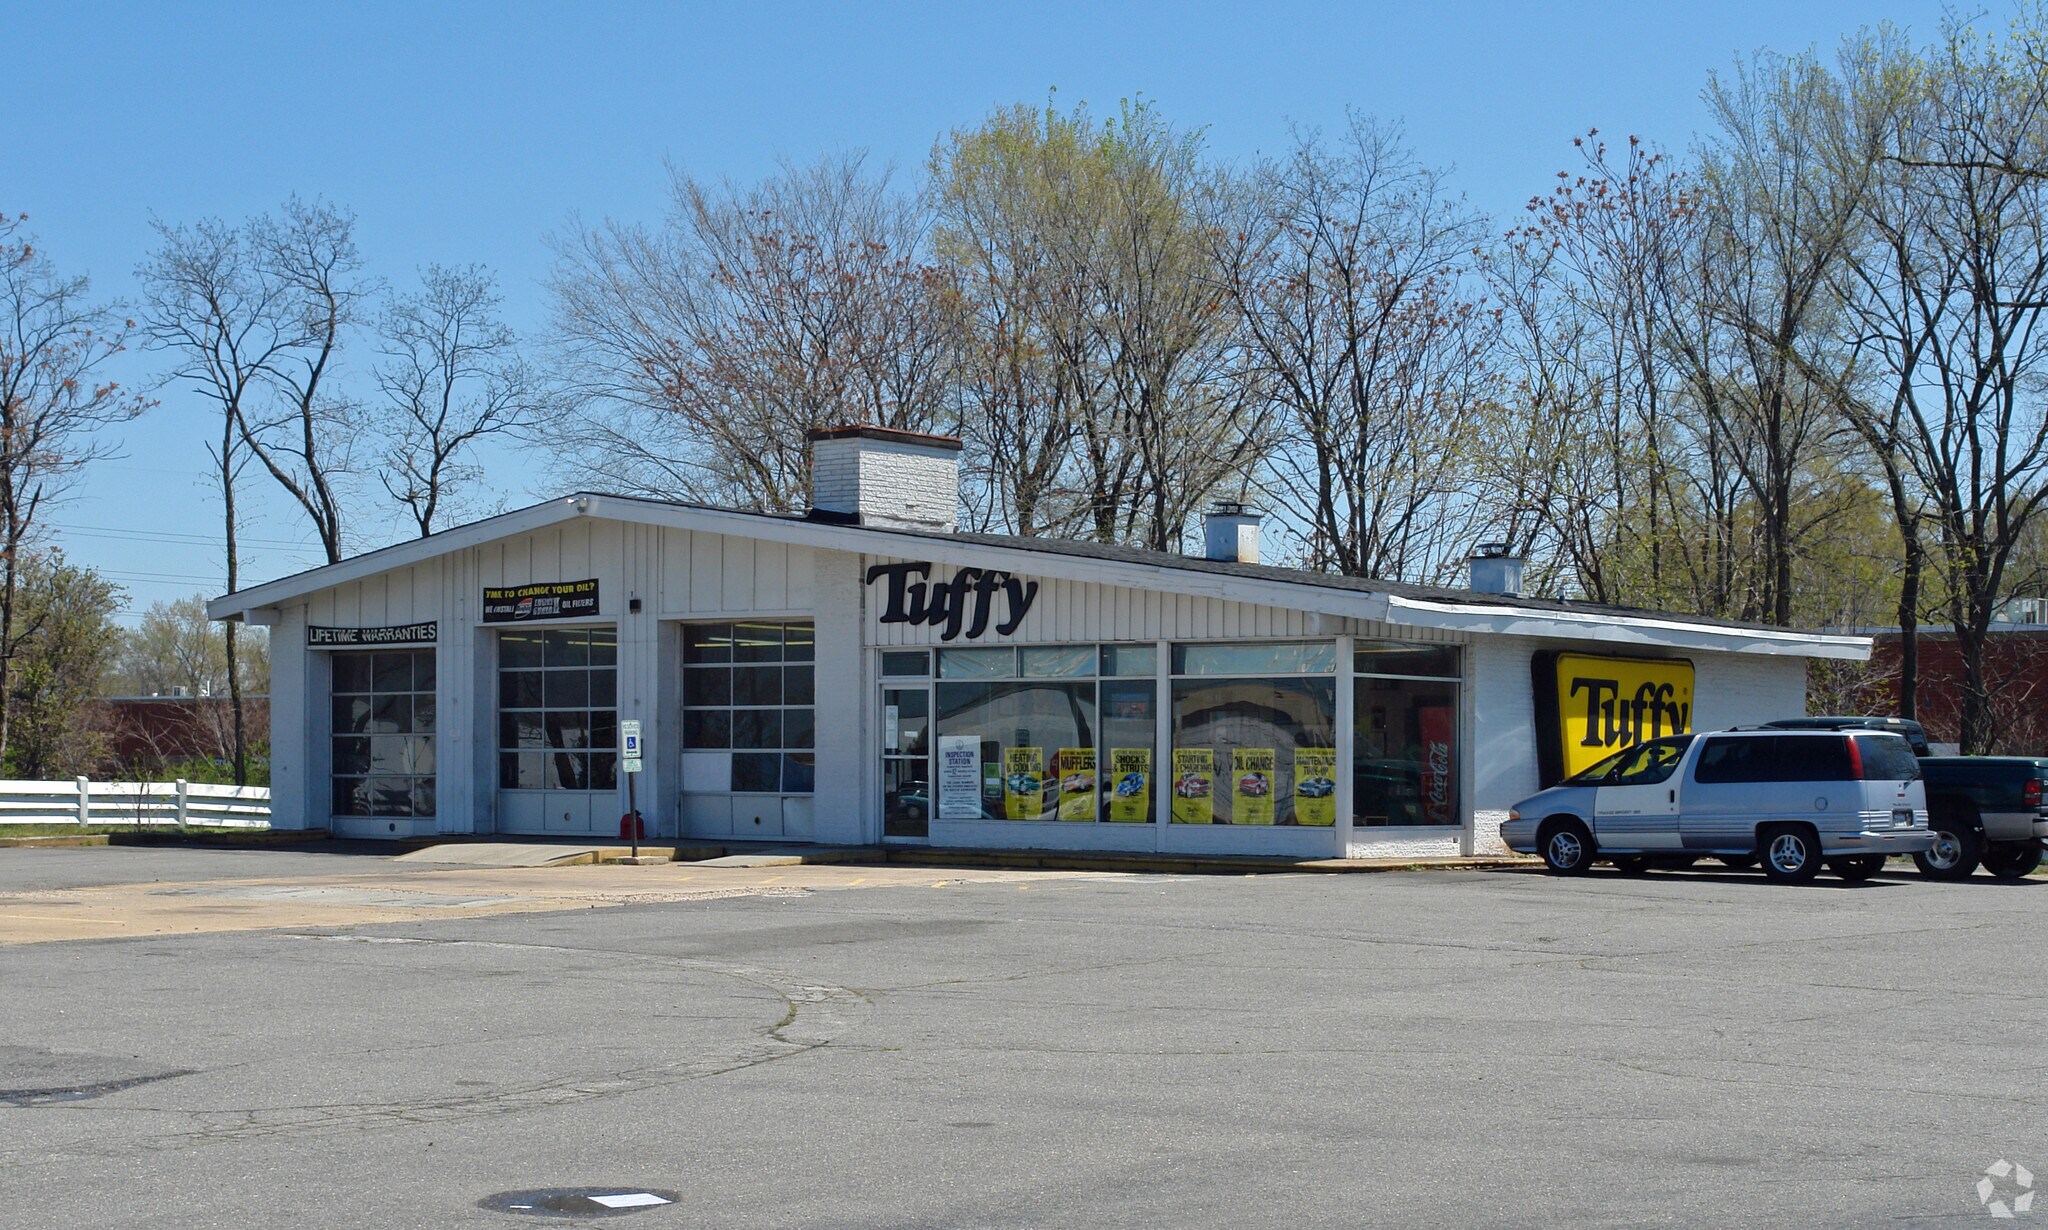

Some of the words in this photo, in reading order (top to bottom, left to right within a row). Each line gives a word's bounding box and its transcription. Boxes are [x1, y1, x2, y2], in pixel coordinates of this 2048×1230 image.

[504, 590, 515, 598] TO
[517, 586, 549, 597] CHANGE
[552, 584, 574, 594] YOUR
[576, 582, 595, 592] OIL?
[866, 562, 1038, 640] Tuffy
[310, 628, 358, 642] LIFETIME
[361, 624, 436, 642] WARRANTIES
[1570, 677, 1688, 748] Tuffy
[1060, 756, 1096, 770] MUFFLERS
[1115, 754, 1146, 764] SHOCKS
[1245, 756, 1274, 771] CHANGE
[1120, 763, 1150, 773] STRUTS
